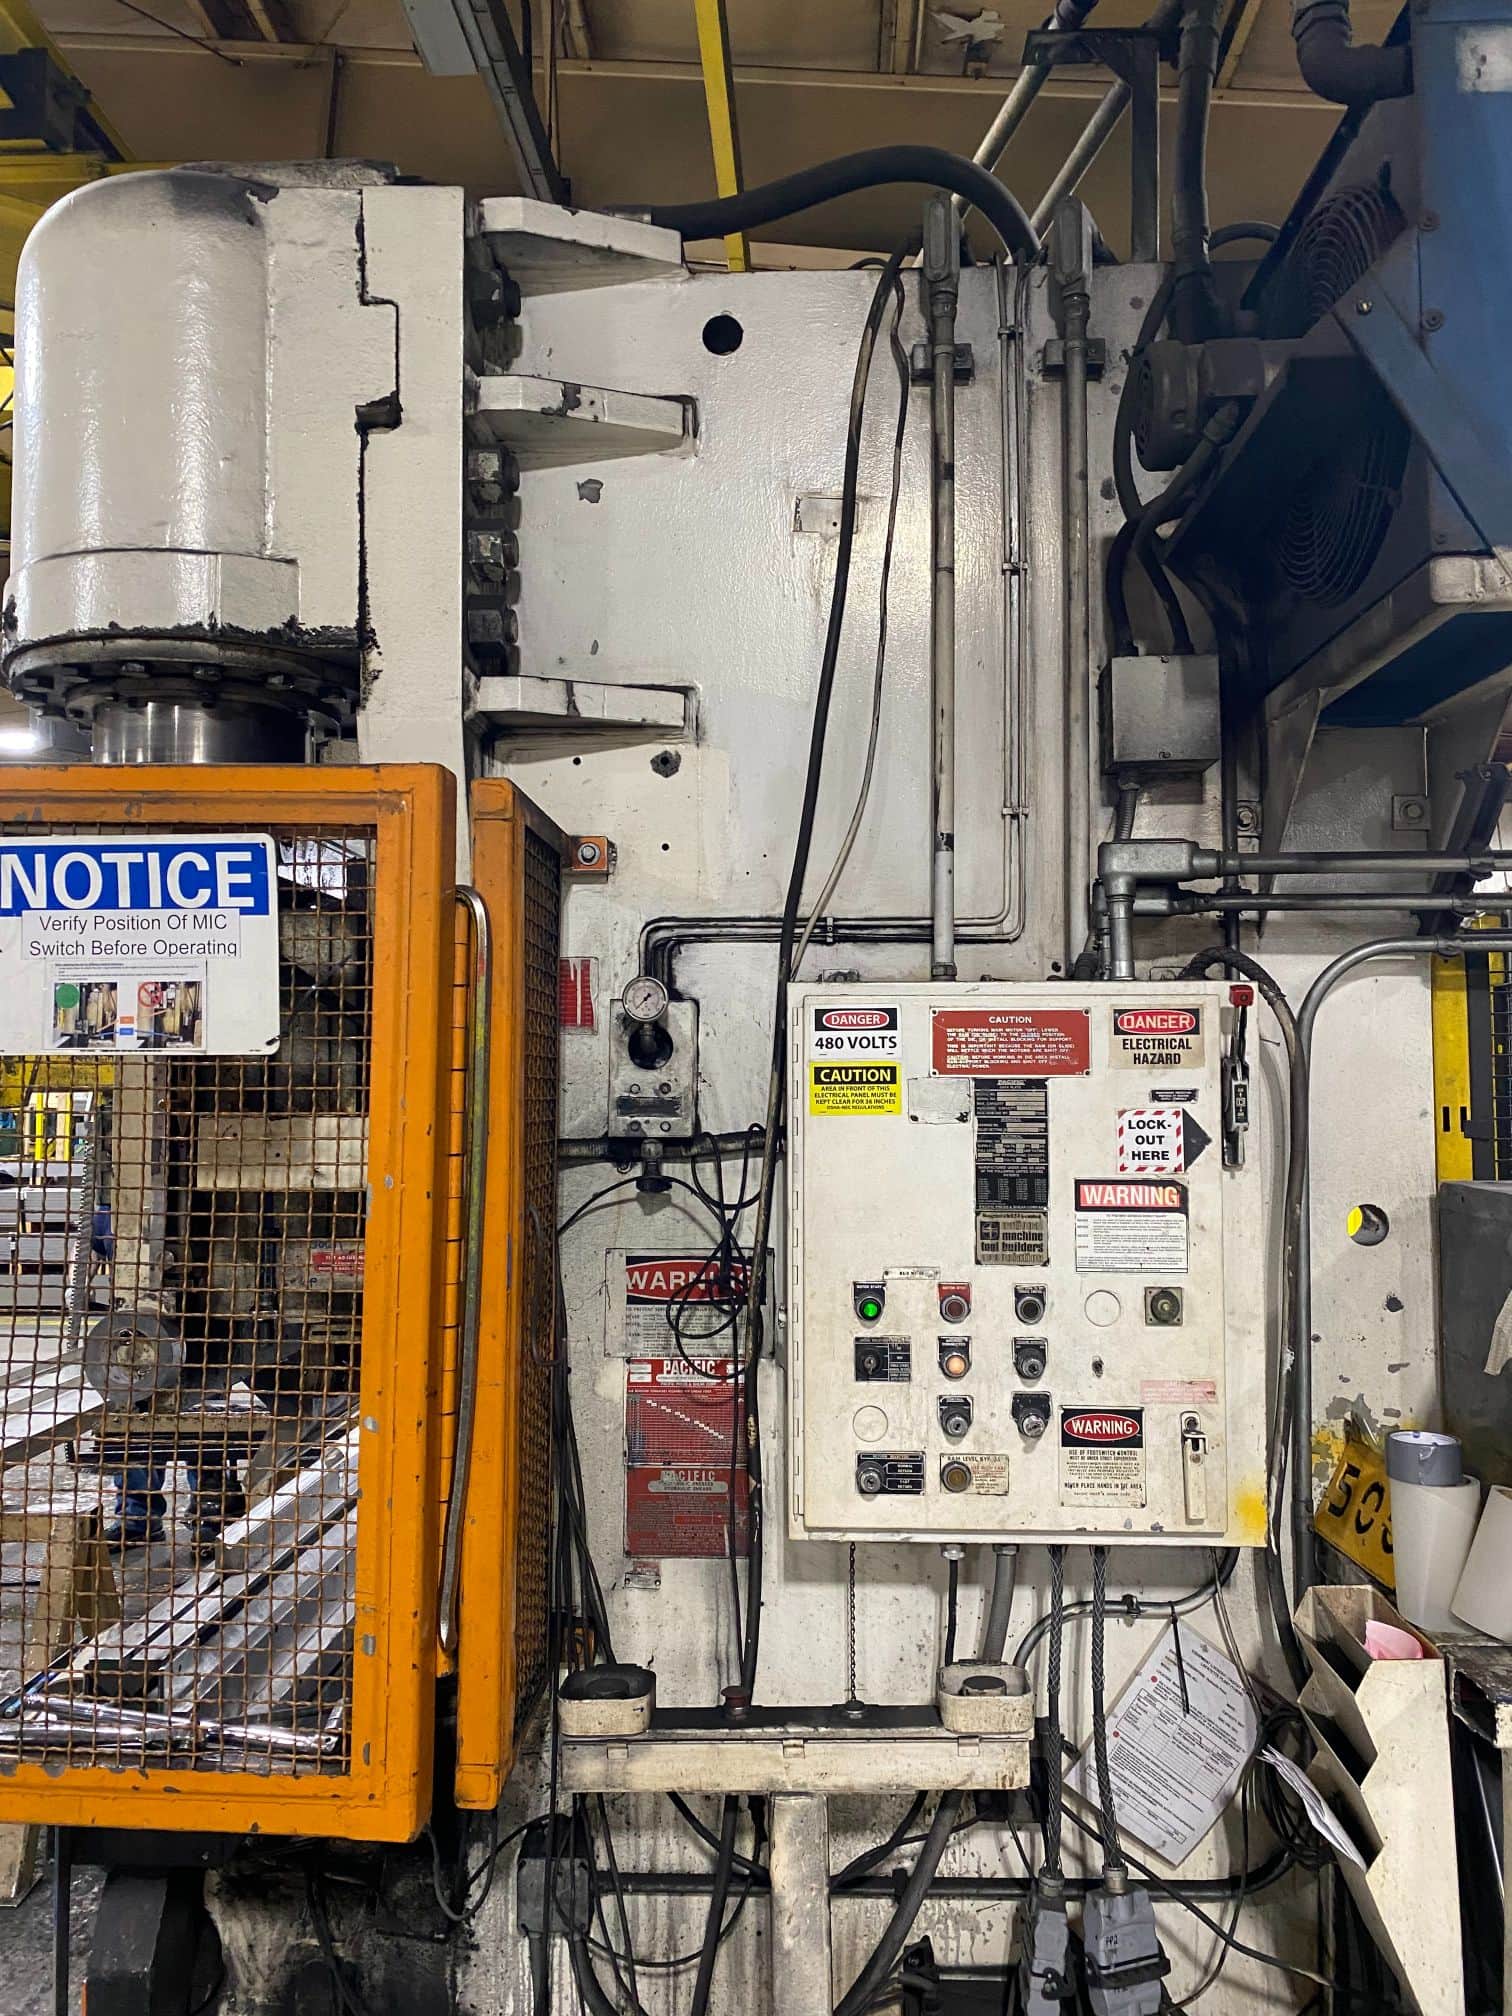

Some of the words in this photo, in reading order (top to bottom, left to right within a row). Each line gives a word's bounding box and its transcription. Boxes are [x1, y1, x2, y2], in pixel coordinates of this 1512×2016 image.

[0, 851, 255, 909] NOTICE
[40, 915, 88, 935] Verify
[93, 914, 161, 931] Position
[167, 914, 190, 930] Of
[193, 914, 228, 930] MIC
[30, 940, 85, 956] Switch
[91, 940, 147, 956] Before
[153, 940, 238, 957] Operating
[831, 1014, 881, 1025] DANGER
[988, 1016, 1032, 1024] CAUTION
[1122, 1015, 1191, 1029] DANGER
[814, 1036, 844, 1050] 480
[847, 1036, 898, 1048] VOLTS
[1122, 1038, 1192, 1050] ELECTRICAL
[1133, 1052, 1182, 1066] HAZARD
[820, 1068, 891, 1082] CAUTION
[1128, 1119, 1172, 1130] LOCK-
[1134, 1135, 1165, 1145] OUT
[1131, 1150, 1170, 1161] HERE
[1084, 1186, 1178, 1205] WARNING
[1002, 1231, 1043, 1241] machine
[626, 1271, 753, 1290] WARN
[1072, 1420, 1133, 1434] WARNING
